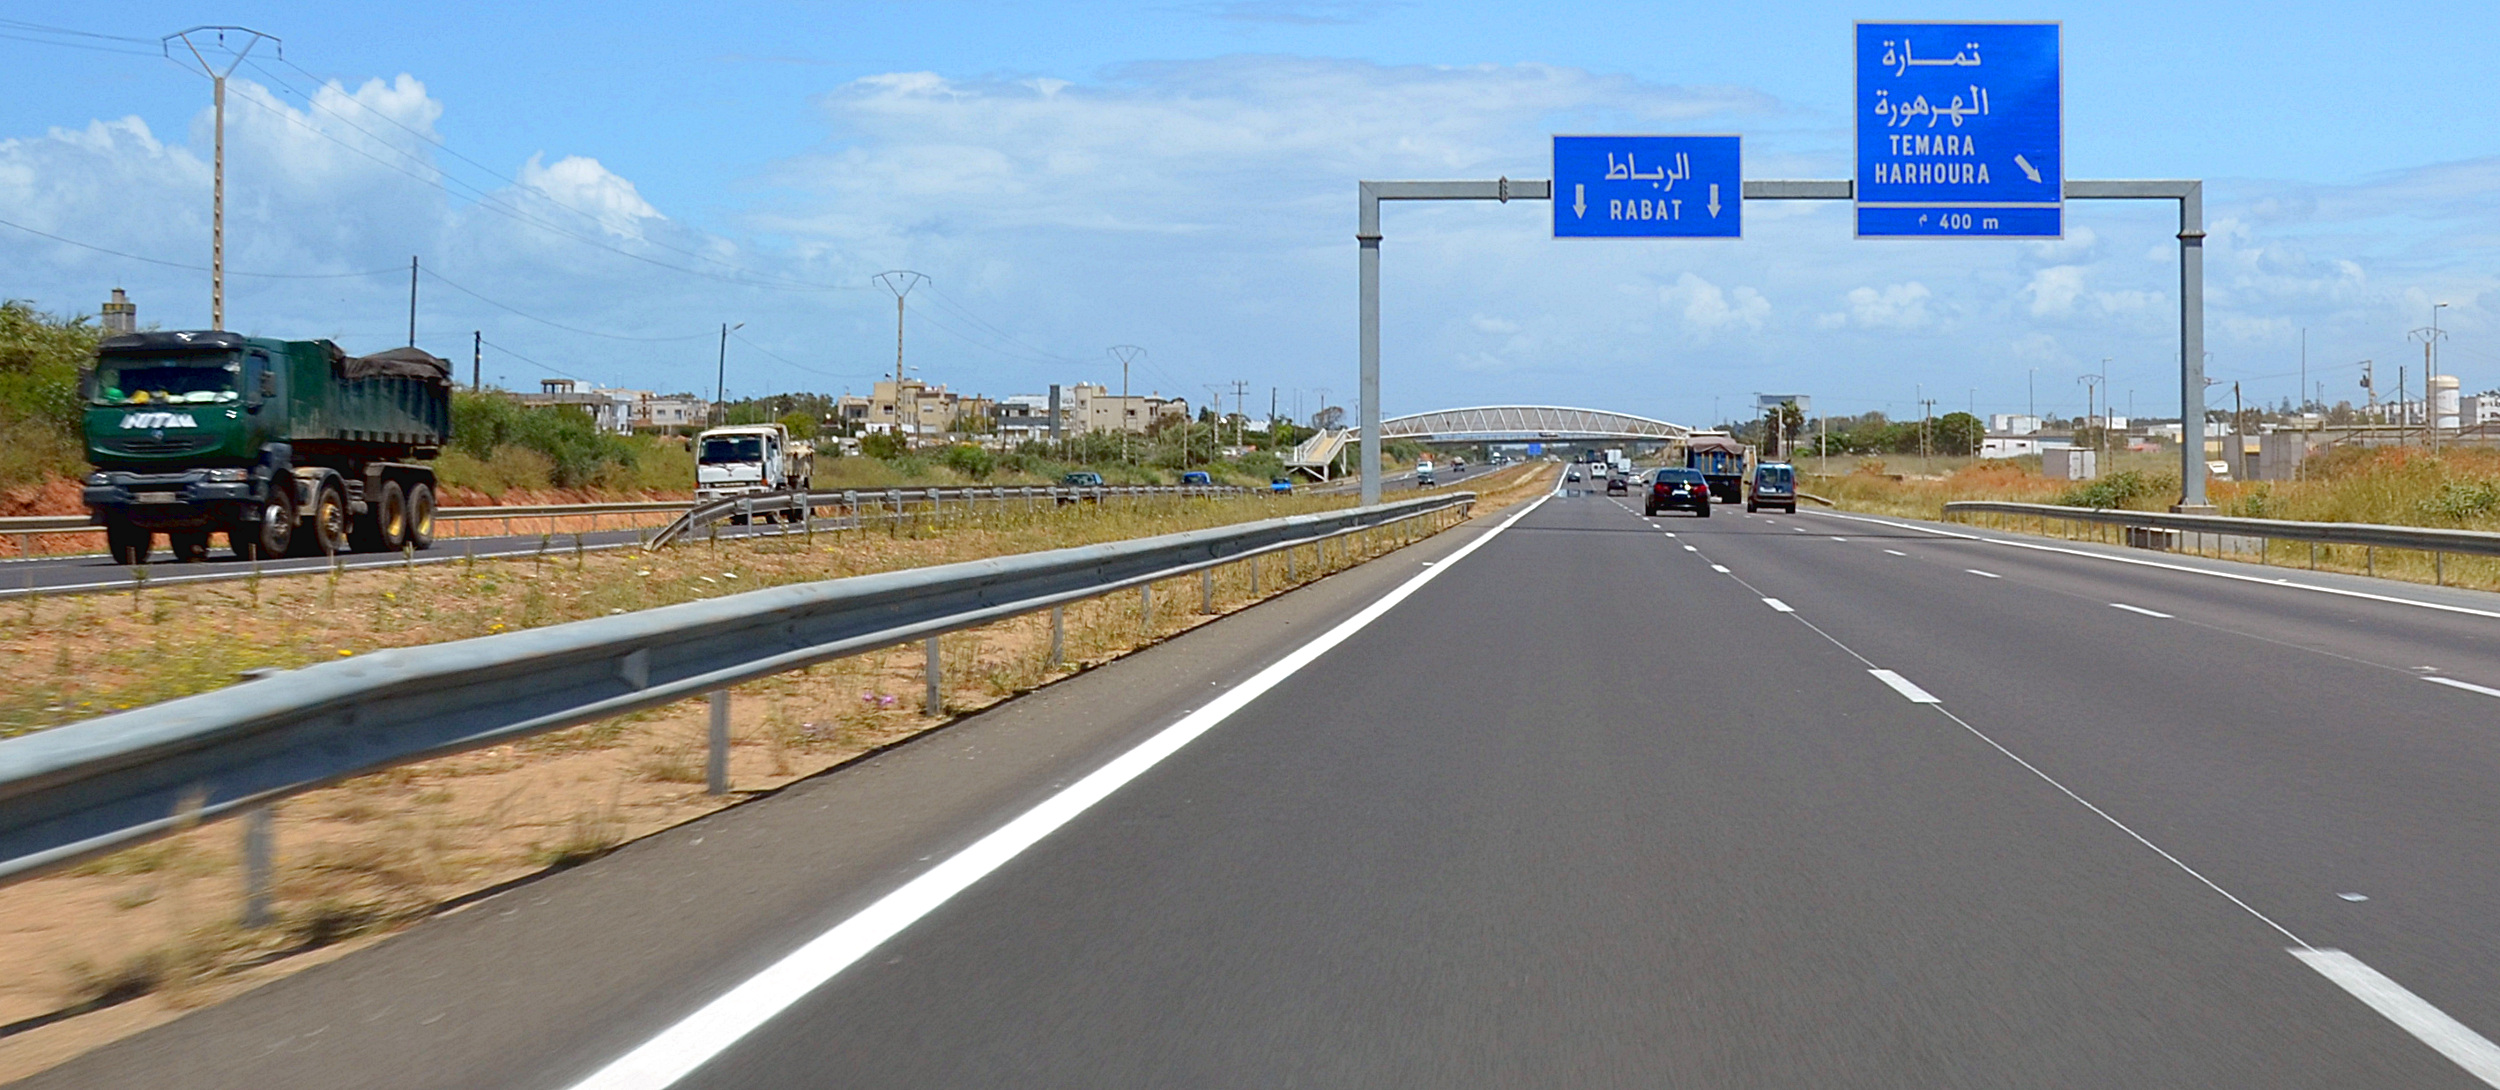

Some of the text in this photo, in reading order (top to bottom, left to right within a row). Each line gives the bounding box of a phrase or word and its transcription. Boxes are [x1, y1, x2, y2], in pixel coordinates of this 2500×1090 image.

[1883, 38, 1981, 76] تمارة
[1875, 85, 1989, 127] الهرهورة
[1890, 135, 1975, 156] TEMARA
[1605, 152, 1690, 192] الرباط
[1875, 162, 1990, 184] HARHOURA
[1610, 199, 1682, 221] RABAT
[1940, 214, 1999, 230] 400 m
